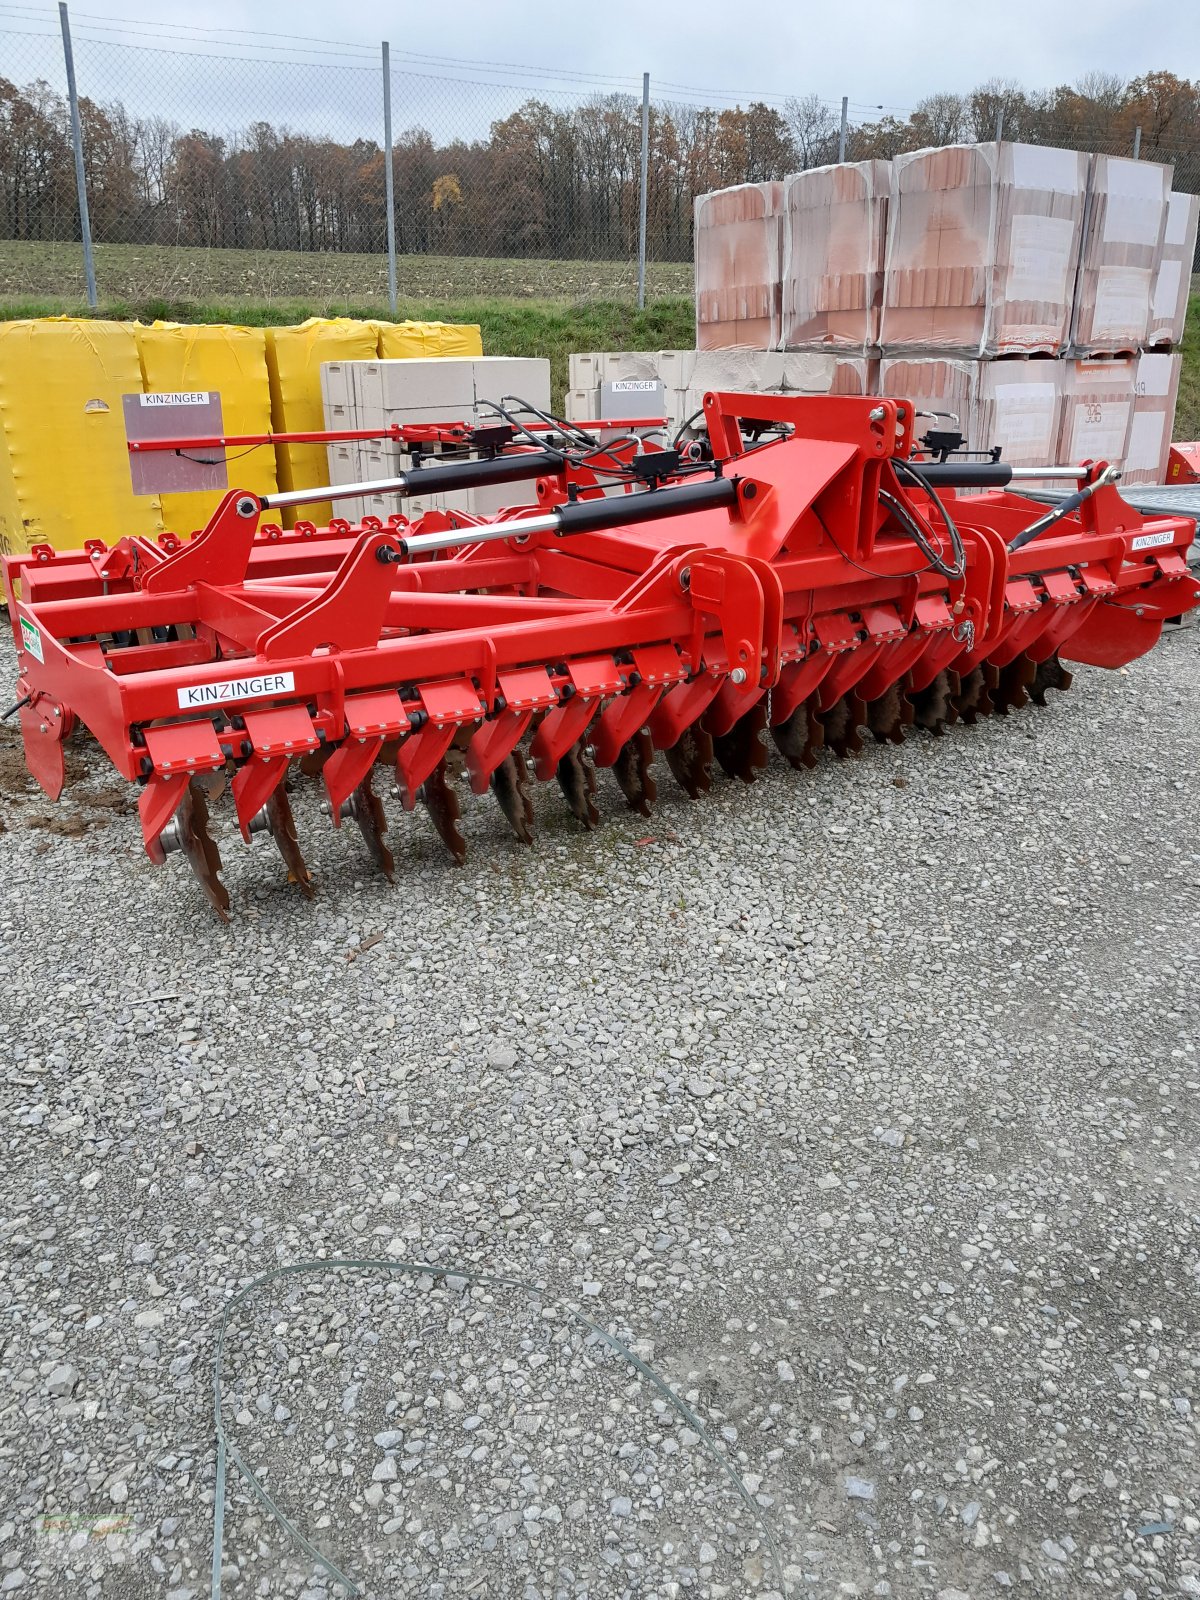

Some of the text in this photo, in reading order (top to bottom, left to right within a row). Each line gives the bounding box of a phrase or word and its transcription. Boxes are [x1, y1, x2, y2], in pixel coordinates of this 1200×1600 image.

[615, 381, 654, 391] KINZINGER
[145, 393, 205, 404] KINZINGER
[1135, 533, 1171, 548] KINZINGER
[188, 676, 286, 703] KINZINGER
